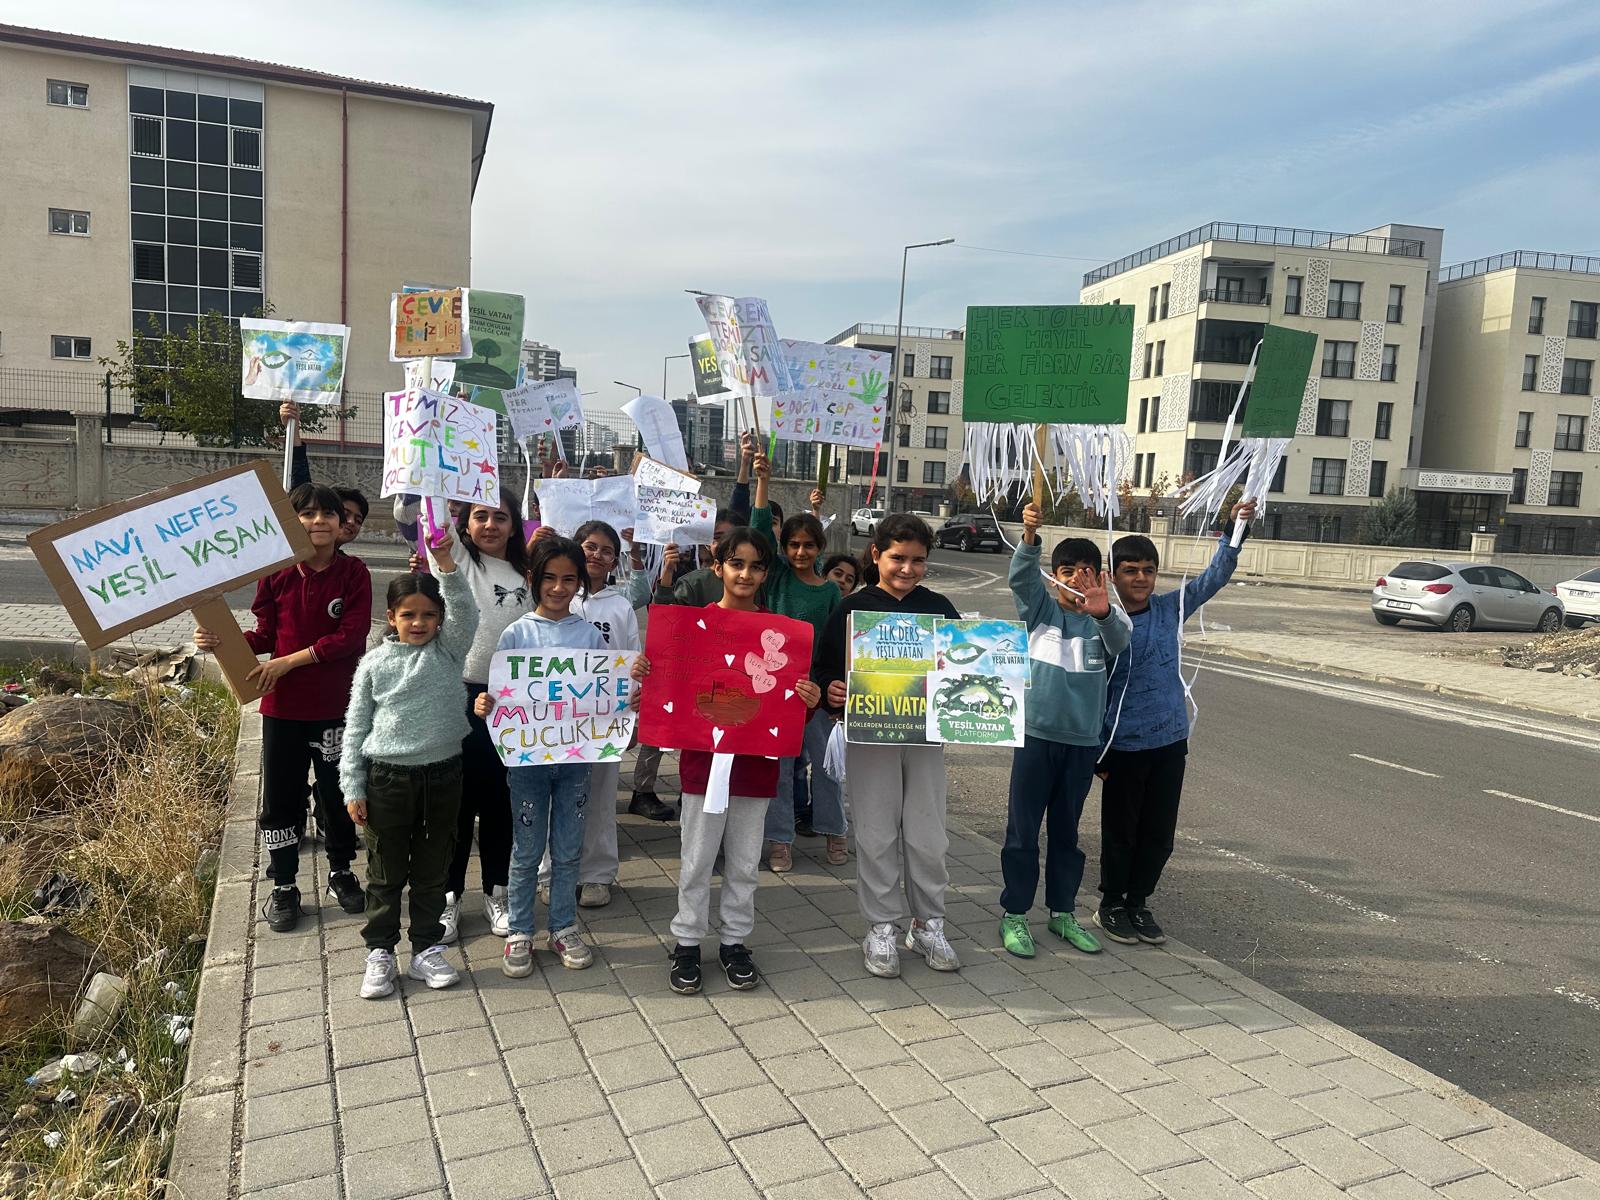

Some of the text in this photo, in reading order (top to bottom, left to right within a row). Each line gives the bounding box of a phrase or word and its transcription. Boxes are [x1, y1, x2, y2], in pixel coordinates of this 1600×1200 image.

[489, 311, 512, 320] VATAN
[970, 306, 1134, 329] HER TOHUM
[1026, 329, 1094, 349] HAYAL
[966, 353, 1008, 375] HER
[388, 393, 459, 424] TEMİZ
[390, 438, 471, 473] MUTLU
[70, 495, 238, 573] MAVİ NEFES
[87, 515, 278, 605] YEŞİL YAŞAM
[879, 624, 920, 643] İLK DERS
[875, 645, 924, 661] YEŞİL VATAN
[992, 656, 1025, 665] YEŞİL VATAN
[507, 652, 610, 680] TEMİZ
[492, 697, 611, 728] MUTLU
[847, 692, 889, 718] YEŞİL
[849, 720, 883, 729] KÖKLERDEN
[884, 722, 914, 730] GELECEĞE
[948, 719, 1005, 732] YEŞİL VATAN
[954, 729, 998, 739] PLATFORMU
